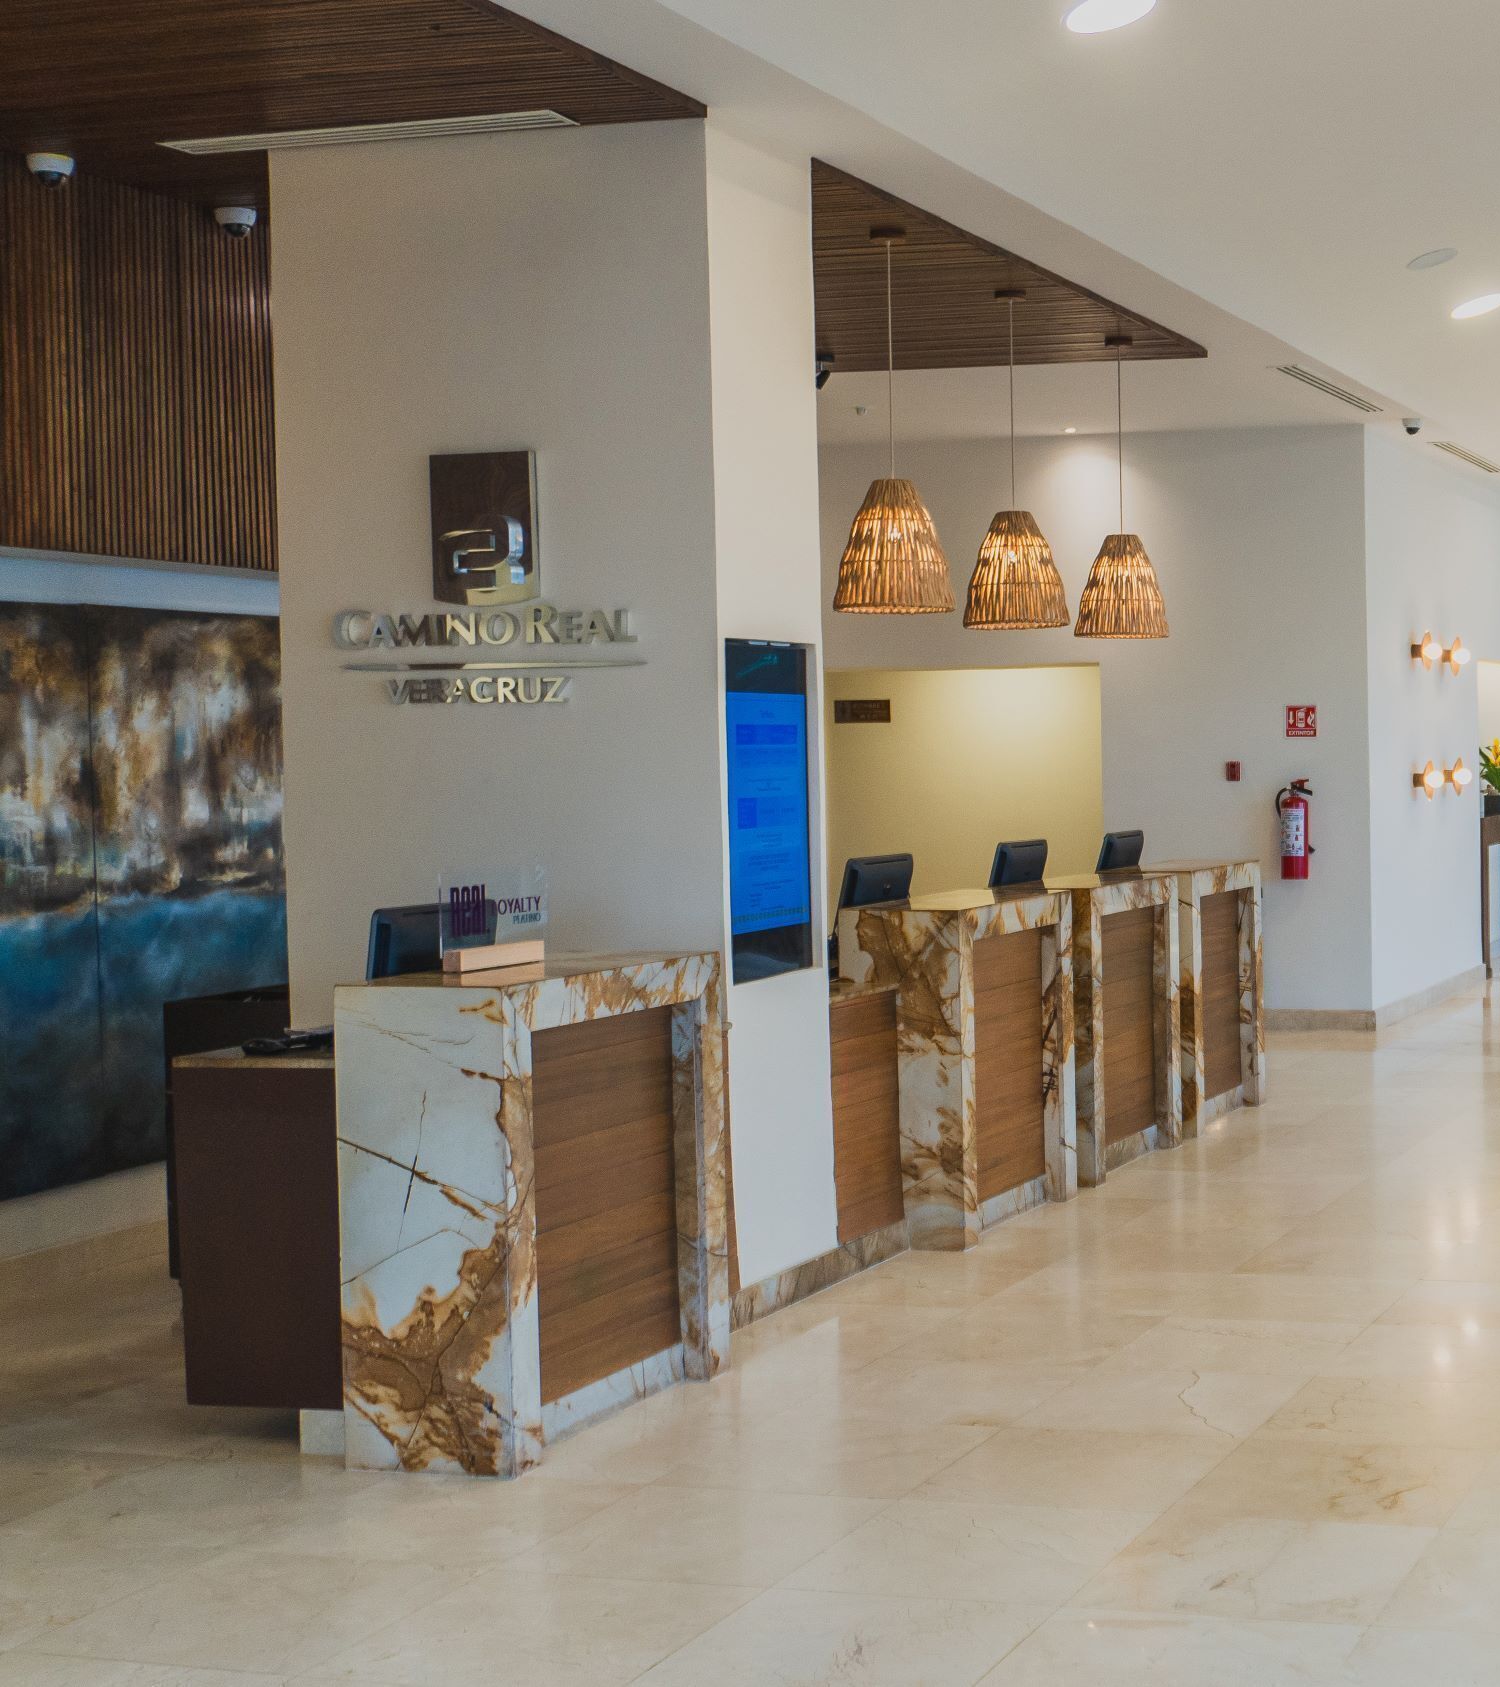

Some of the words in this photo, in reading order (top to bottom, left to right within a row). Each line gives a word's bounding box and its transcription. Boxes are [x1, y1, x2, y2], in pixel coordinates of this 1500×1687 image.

[333, 608, 517, 648] CAMINO
[525, 605, 638, 644] REAL
[387, 676, 570, 704] VERACRUZ
